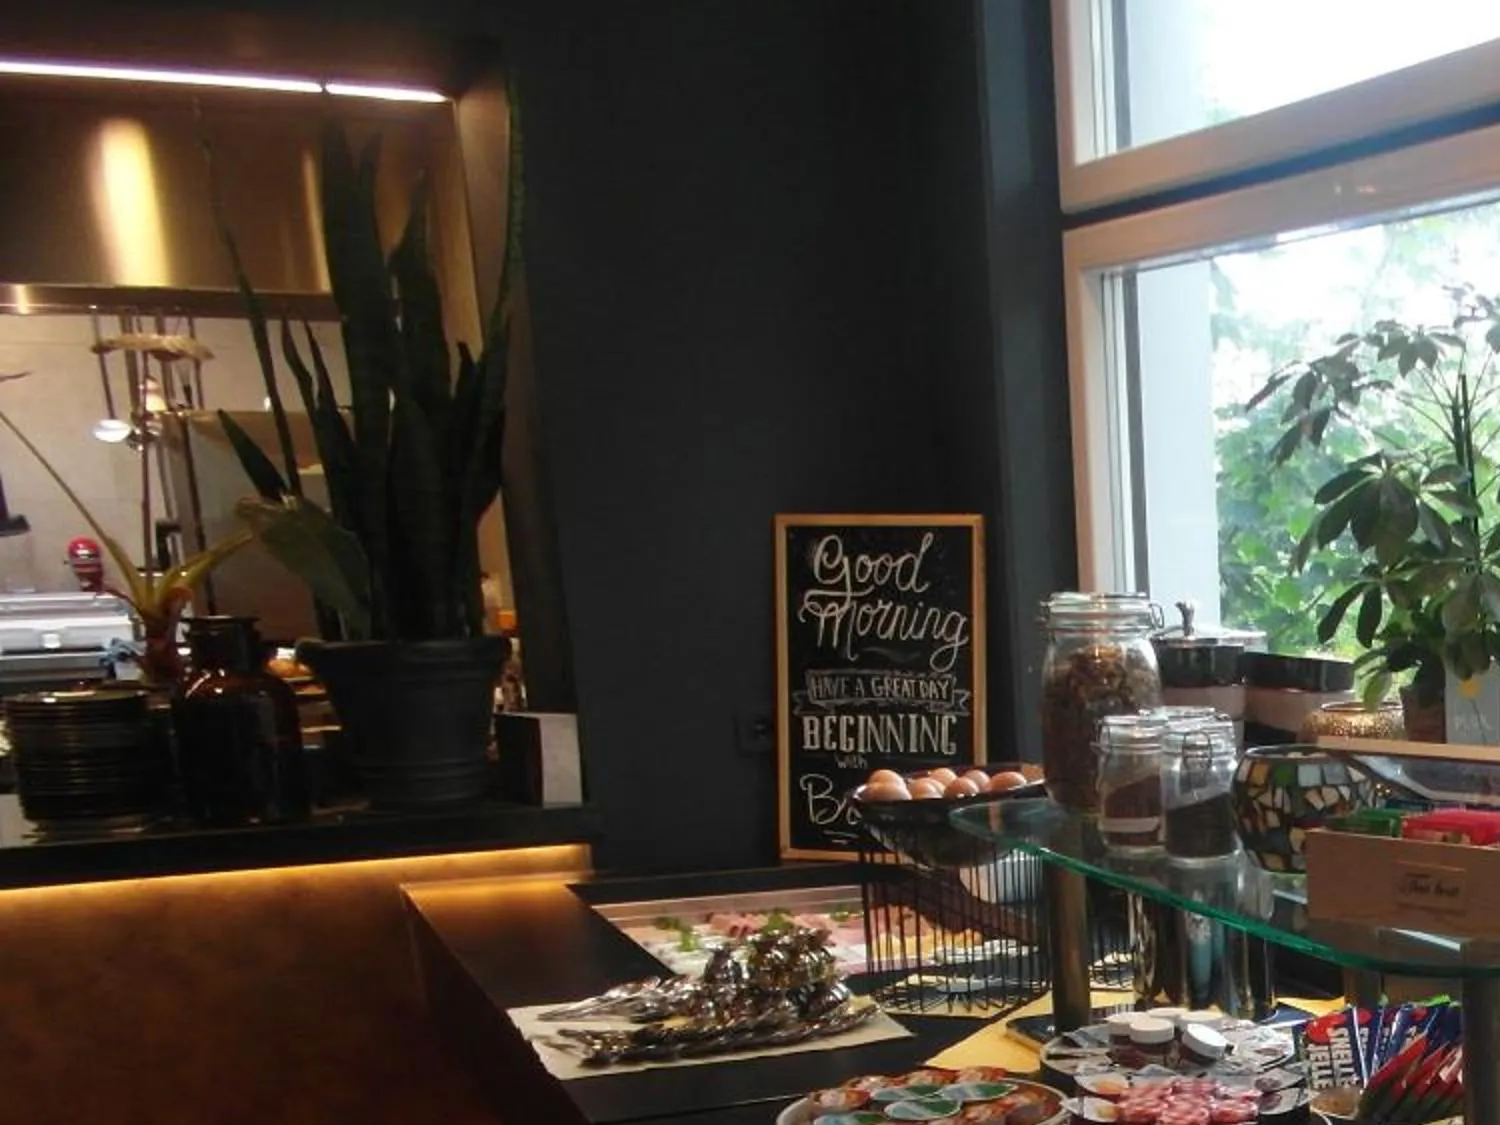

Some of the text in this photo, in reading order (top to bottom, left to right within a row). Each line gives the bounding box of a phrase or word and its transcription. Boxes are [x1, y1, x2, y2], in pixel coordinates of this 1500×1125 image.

[812, 531, 935, 606] Good
[799, 589, 970, 674] Morning
[811, 676, 949, 700] HAVE A GREAT DAY
[802, 713, 957, 755] BEGINNING
[1306, 1043, 1335, 1089] JELLE
[1327, 1026, 1356, 1088] SNELLE
